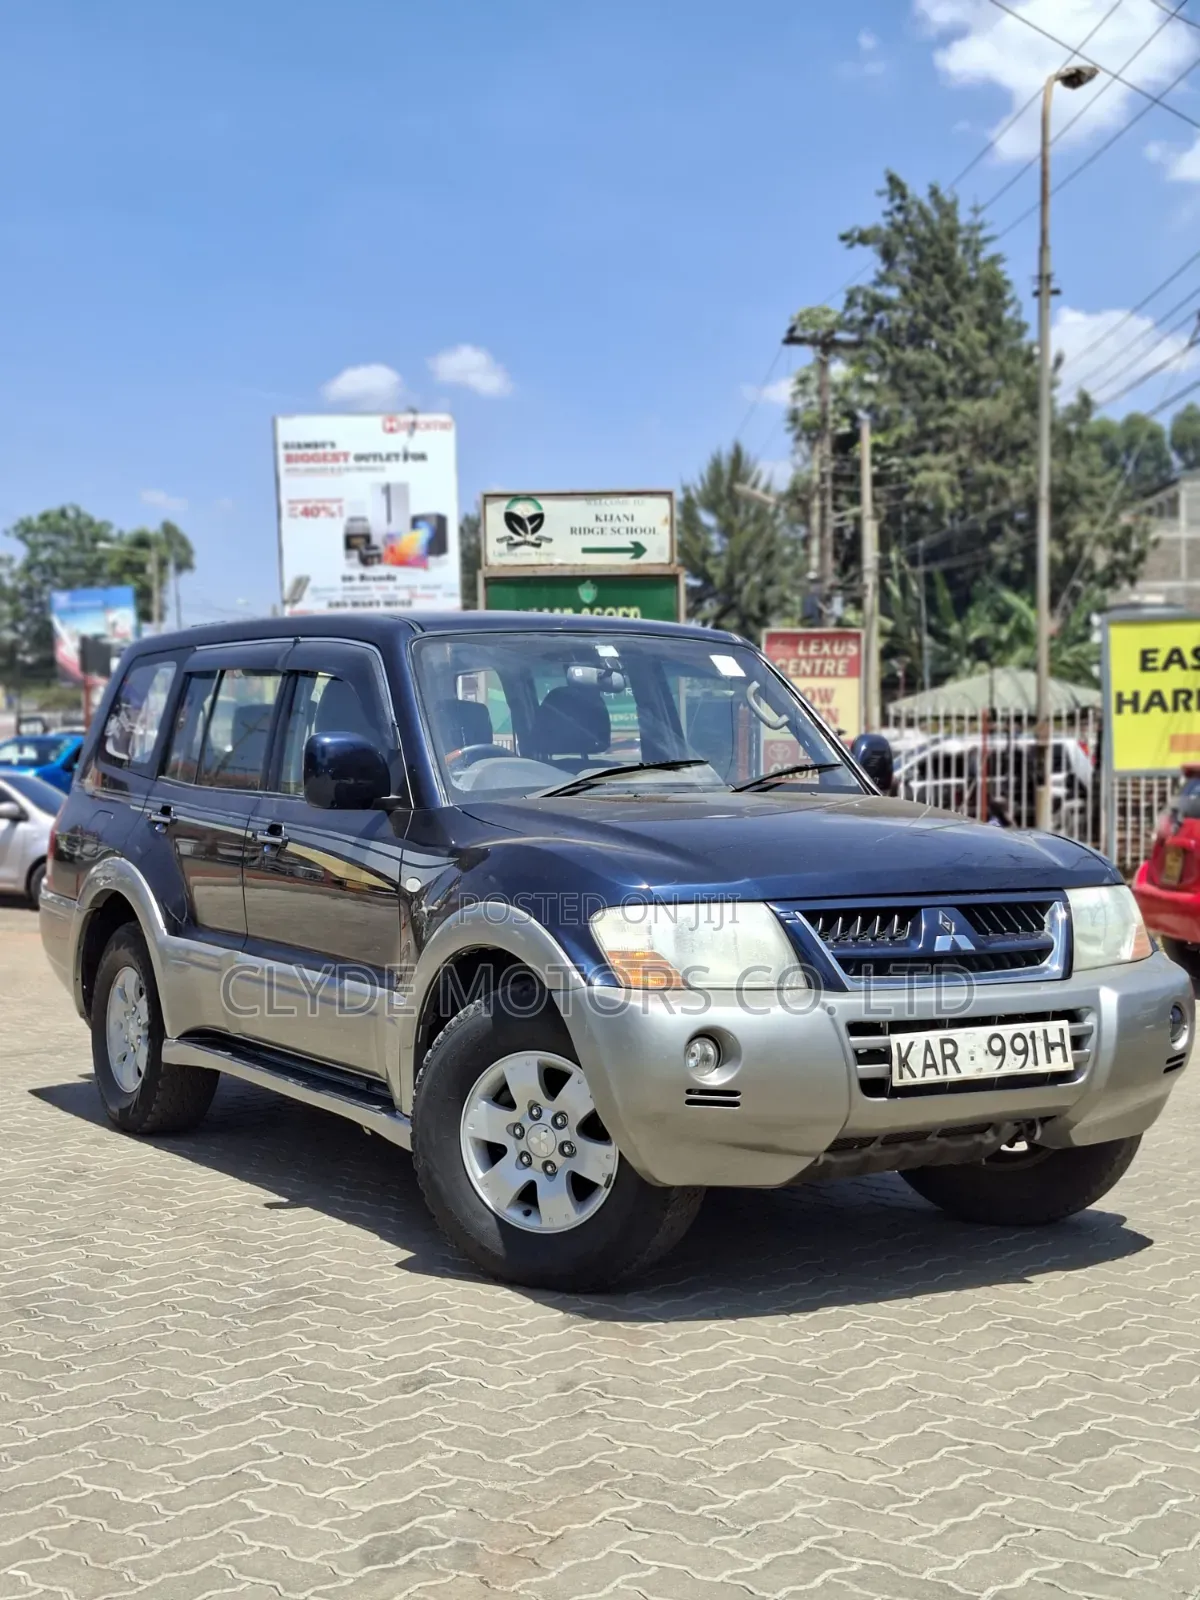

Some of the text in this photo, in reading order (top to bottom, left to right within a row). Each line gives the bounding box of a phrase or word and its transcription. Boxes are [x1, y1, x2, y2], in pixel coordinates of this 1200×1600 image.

[285, 451, 350, 464] BIGGEST
[353, 452, 401, 463] OUTLET
[595, 513, 635, 523] KIJANI
[570, 525, 660, 536] RIDGE SCHOOL
[798, 639, 859, 657] LEXUS
[775, 657, 849, 676] CENTRE
[1115, 687, 1200, 715] HAR
[896, 1028, 1069, 1079] KAR 991H
